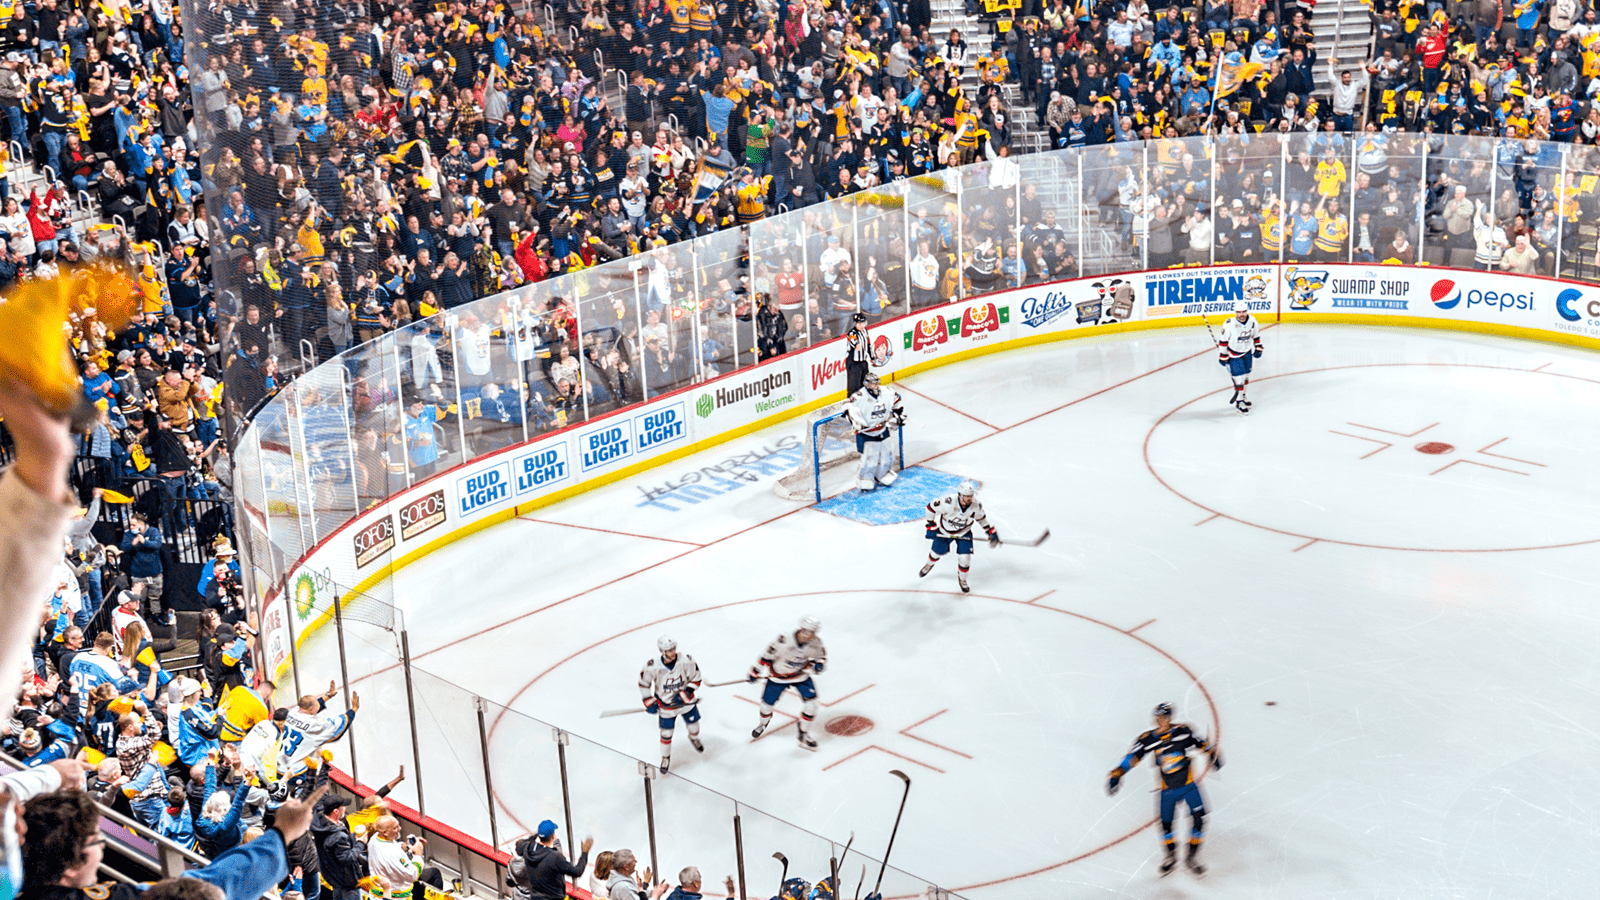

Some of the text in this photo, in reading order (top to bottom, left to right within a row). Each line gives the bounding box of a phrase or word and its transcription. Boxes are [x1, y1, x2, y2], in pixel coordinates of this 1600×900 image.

[1146, 276, 1244, 306] TIREMAN
[1332, 279, 1410, 296] SWAMP SHOP
[1182, 301, 1272, 314] AUTO SERVICE NTERS
[1467, 289, 1534, 312] pepsi
[716, 370, 791, 408] Huntington
[644, 410, 676, 432] BUD
[589, 428, 622, 450] BUD
[639, 420, 682, 448] LIGHT
[524, 450, 558, 473] BUD
[584, 439, 629, 468] LIGHT
[466, 470, 500, 494] BUD
[518, 461, 565, 490] LIGHT
[462, 482, 507, 512] LIGHT
